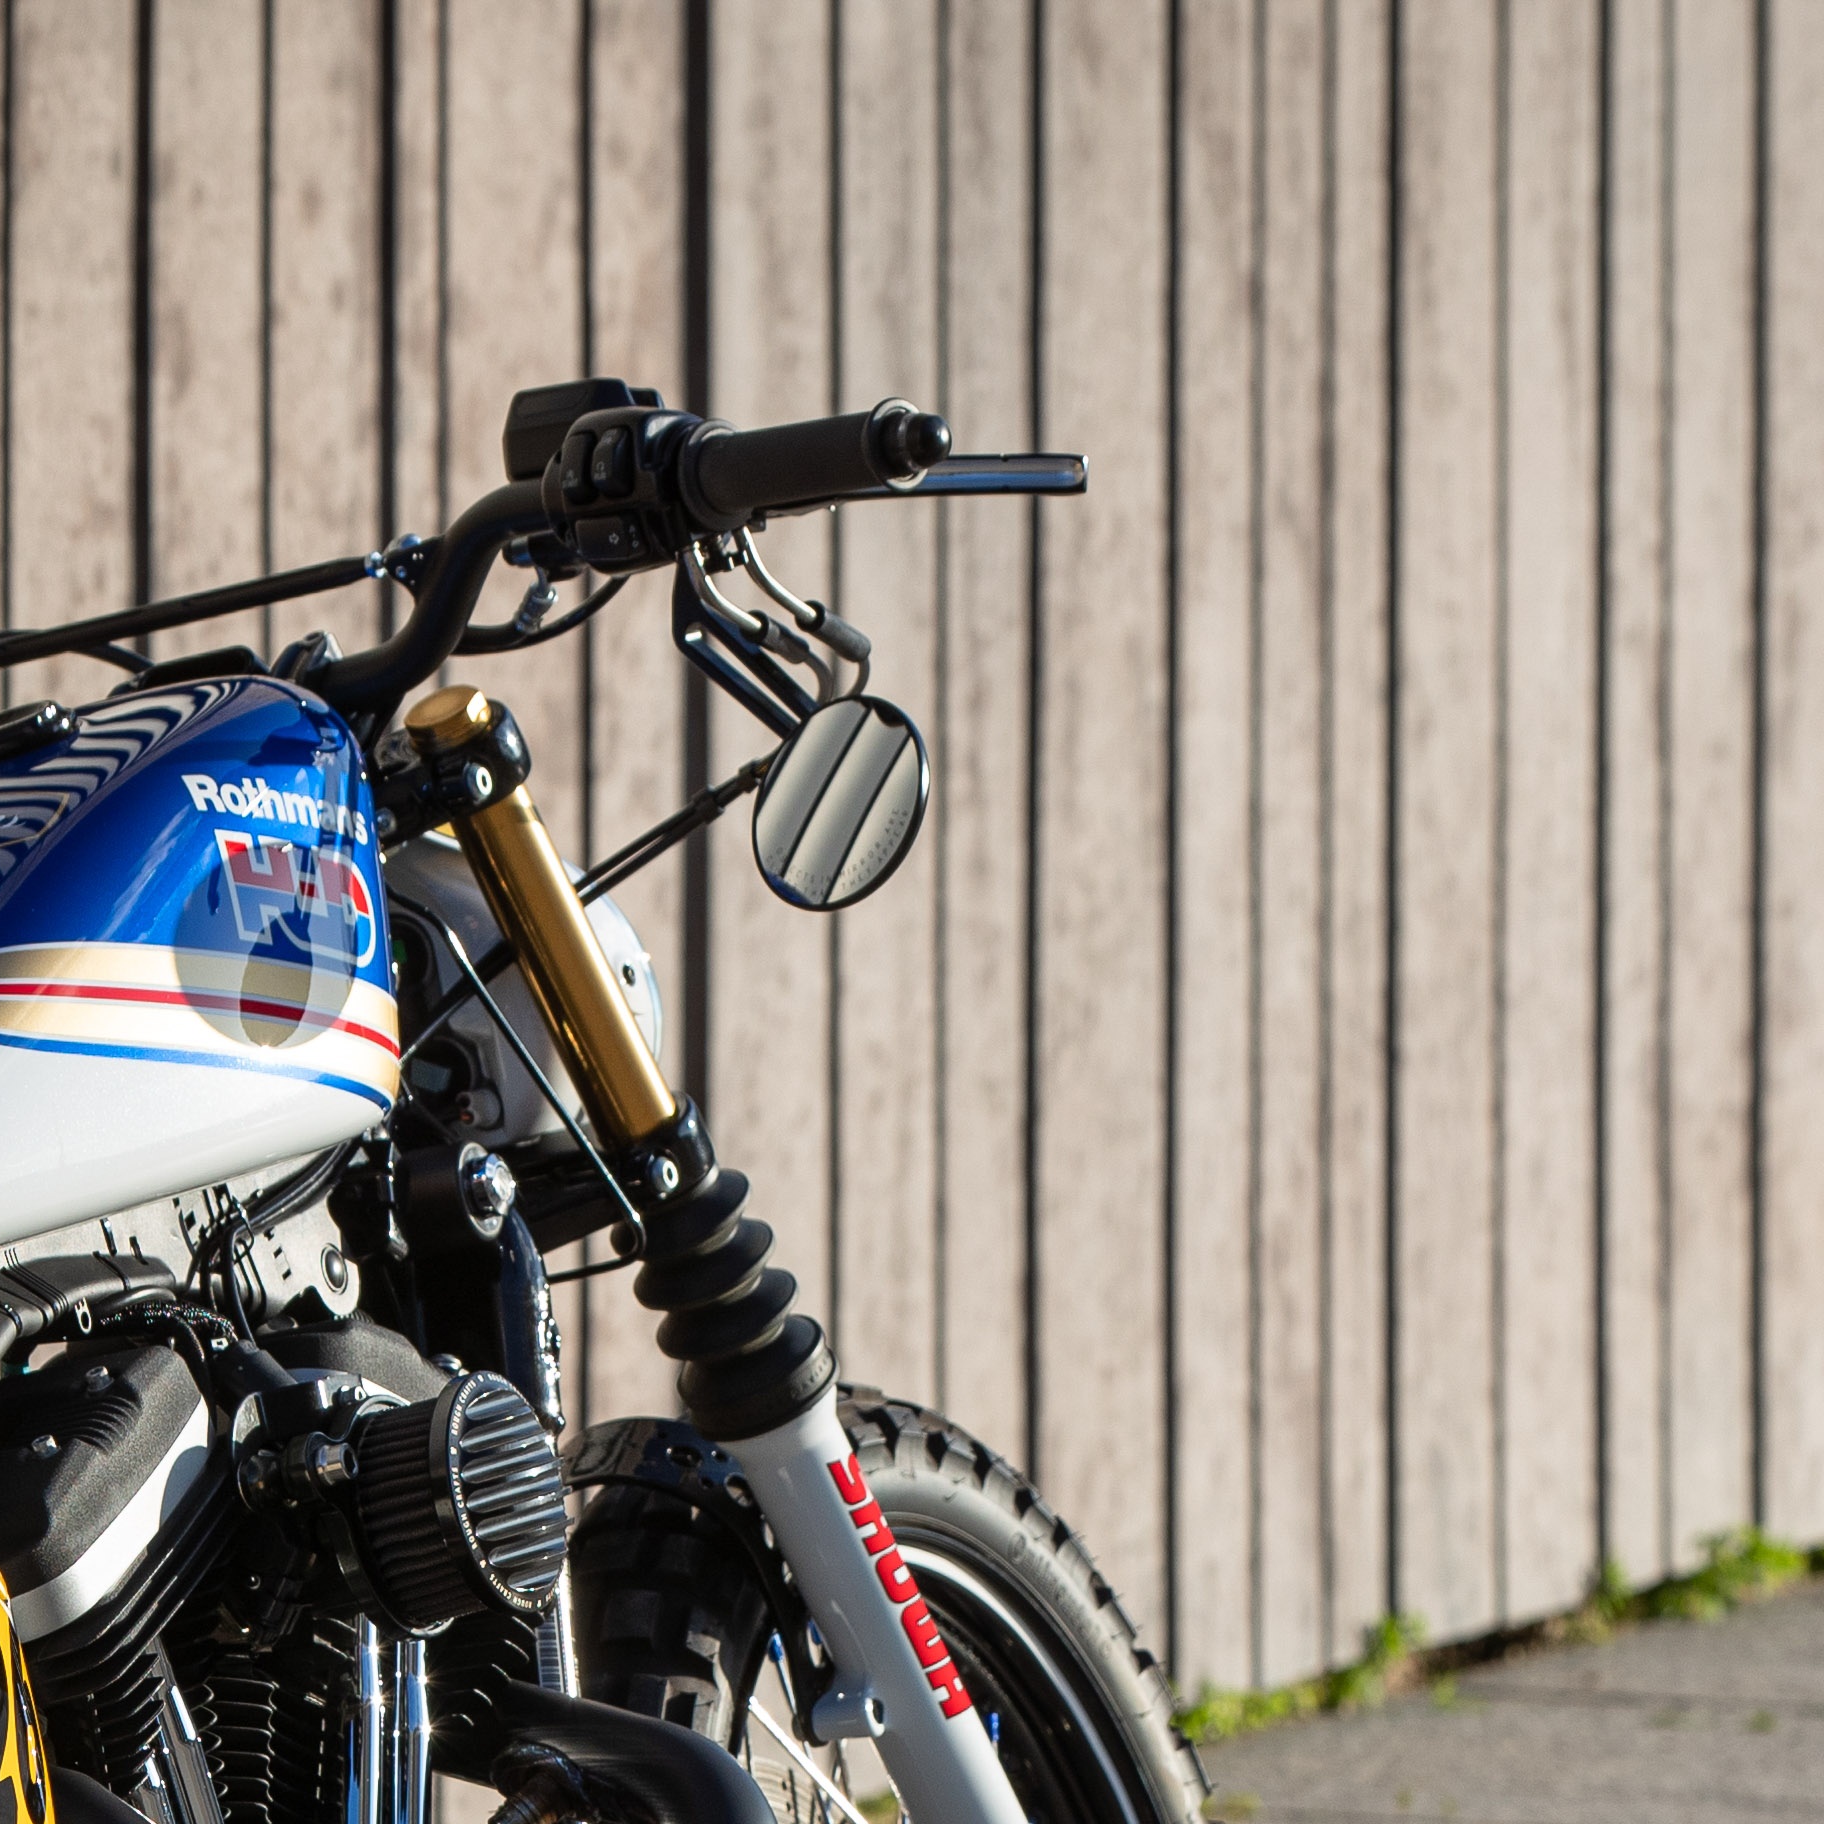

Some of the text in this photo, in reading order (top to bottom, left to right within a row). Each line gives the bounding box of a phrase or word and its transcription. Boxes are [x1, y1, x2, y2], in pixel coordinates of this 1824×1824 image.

[181, 774, 368, 846] Rothmans
[451, 1466, 478, 1550] ROUGH CRAFTS
[826, 1452, 973, 1720] SHOWA
